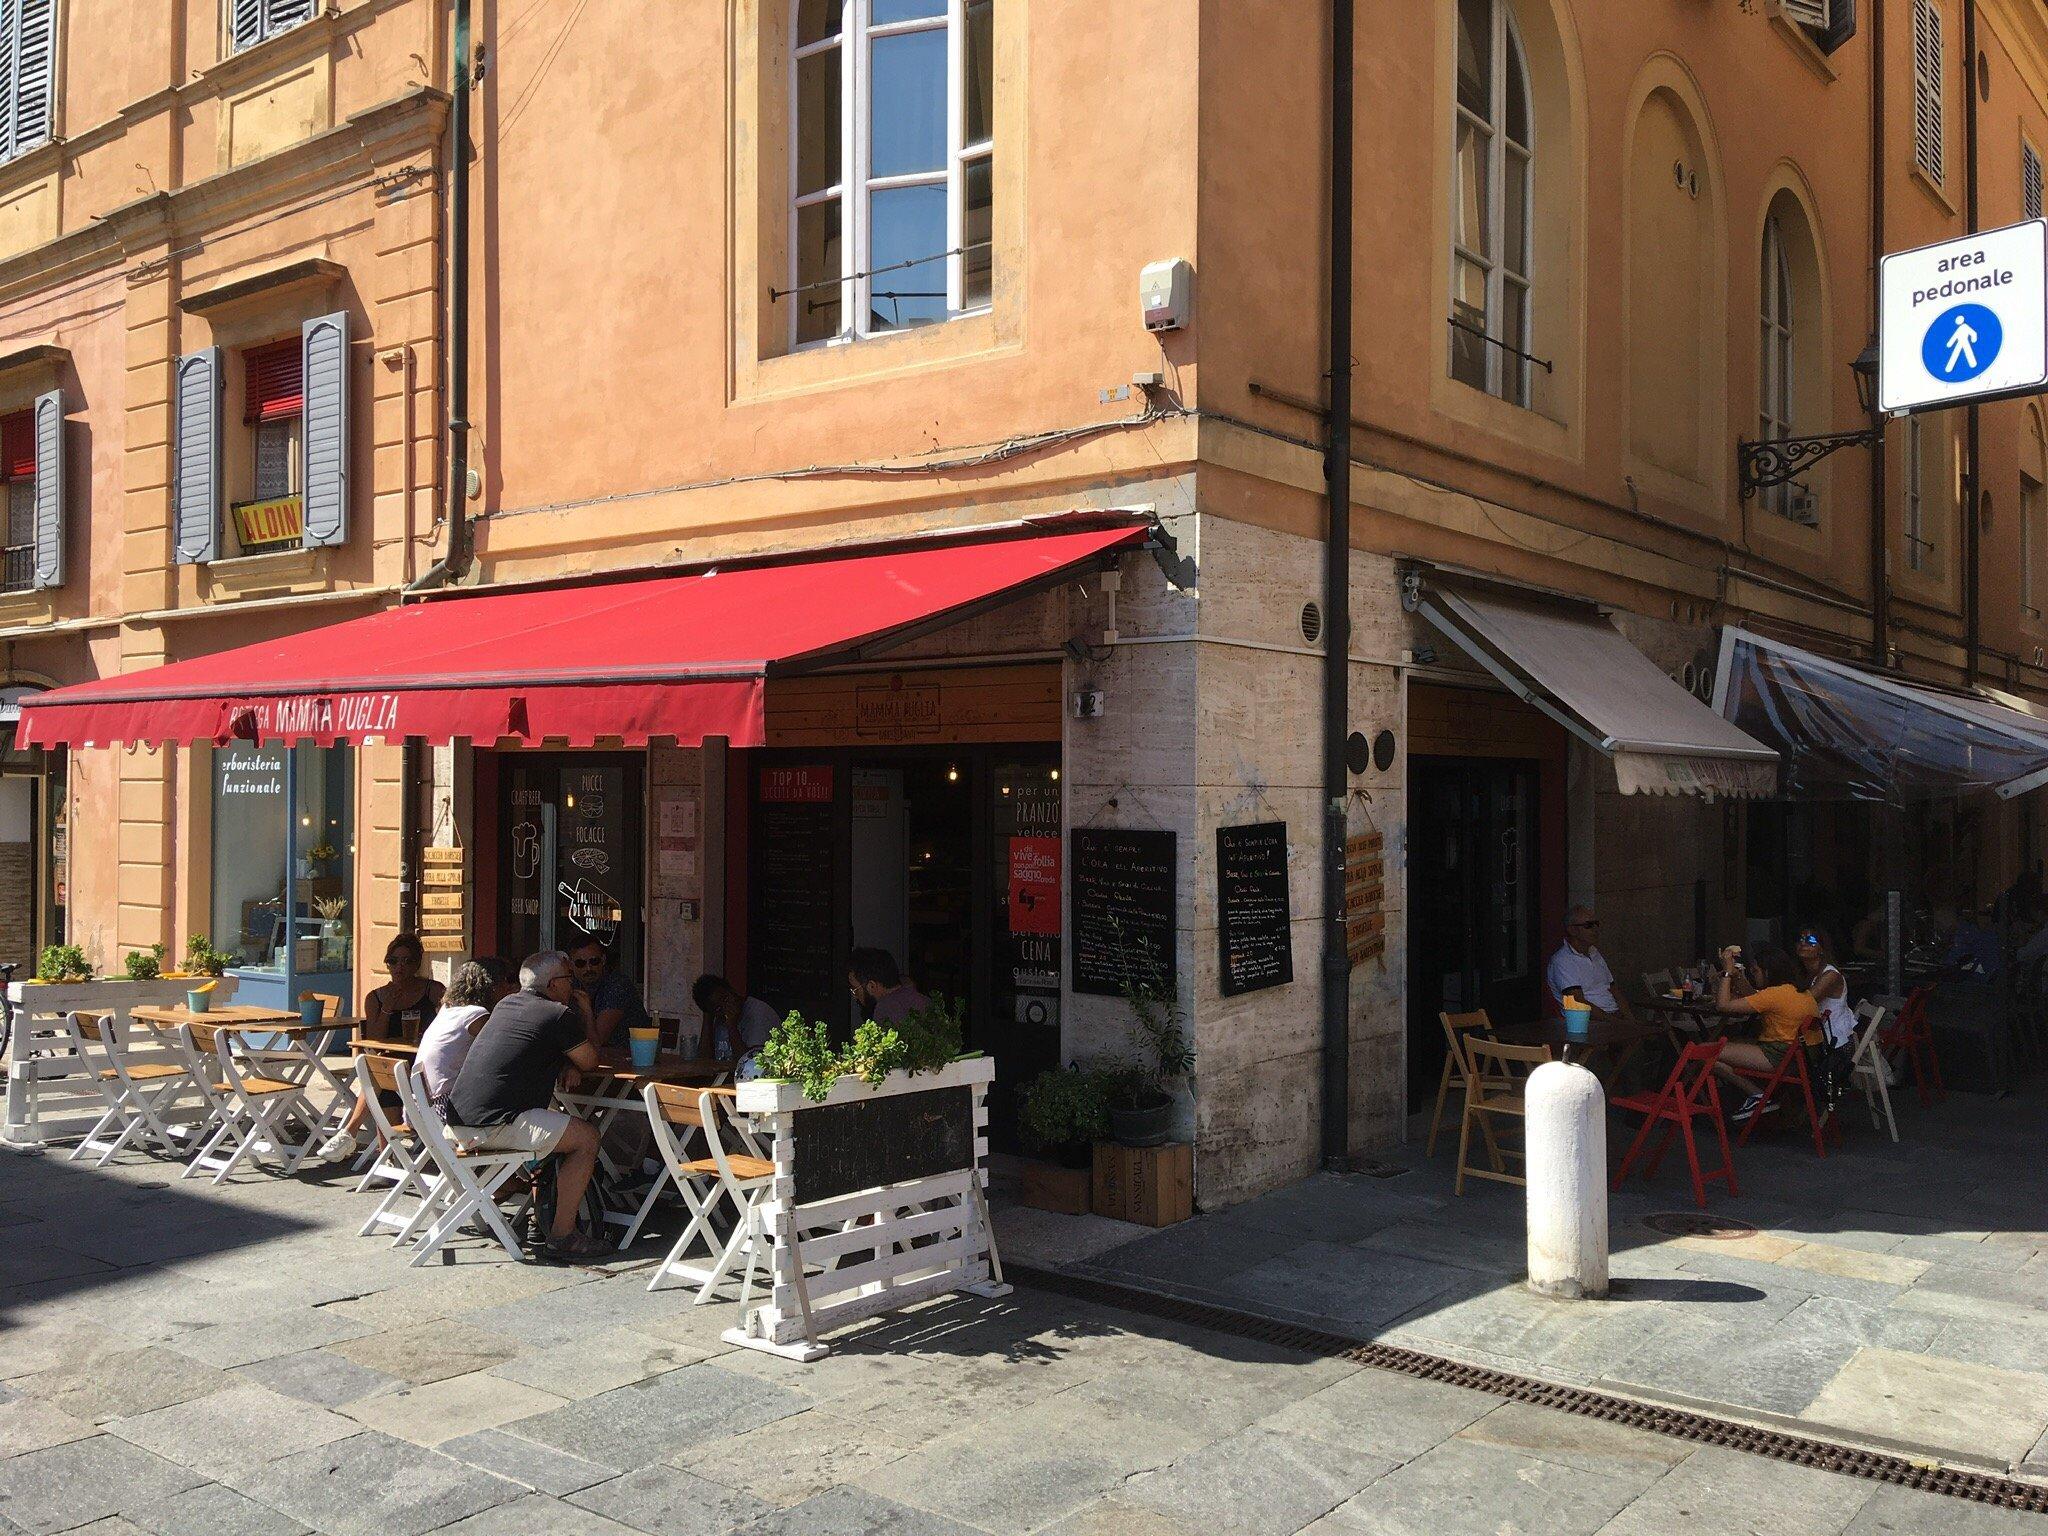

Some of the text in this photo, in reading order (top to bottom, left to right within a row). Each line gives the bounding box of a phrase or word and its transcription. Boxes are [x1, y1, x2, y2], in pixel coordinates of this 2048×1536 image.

[1937, 250, 1986, 273] area
[1912, 268, 2014, 308] pedonale
[338, 695, 399, 731] PUGLIA
[222, 753, 281, 771] erboristeria
[222, 773, 281, 796] funzionale
[581, 774, 603, 792] PUCCE
[772, 770, 792, 786] TOP
[1017, 787, 1058, 799] per un
[1016, 801, 1060, 824] PRANZO
[575, 826, 605, 844] FOCACCE
[1017, 826, 1058, 838] veloce
[1013, 849, 1033, 861] vive
[1013, 869, 1042, 882] saggio
[511, 898, 539, 915] BEER SHOP
[573, 903, 581, 917] DI
[1021, 940, 1051, 961] CENA
